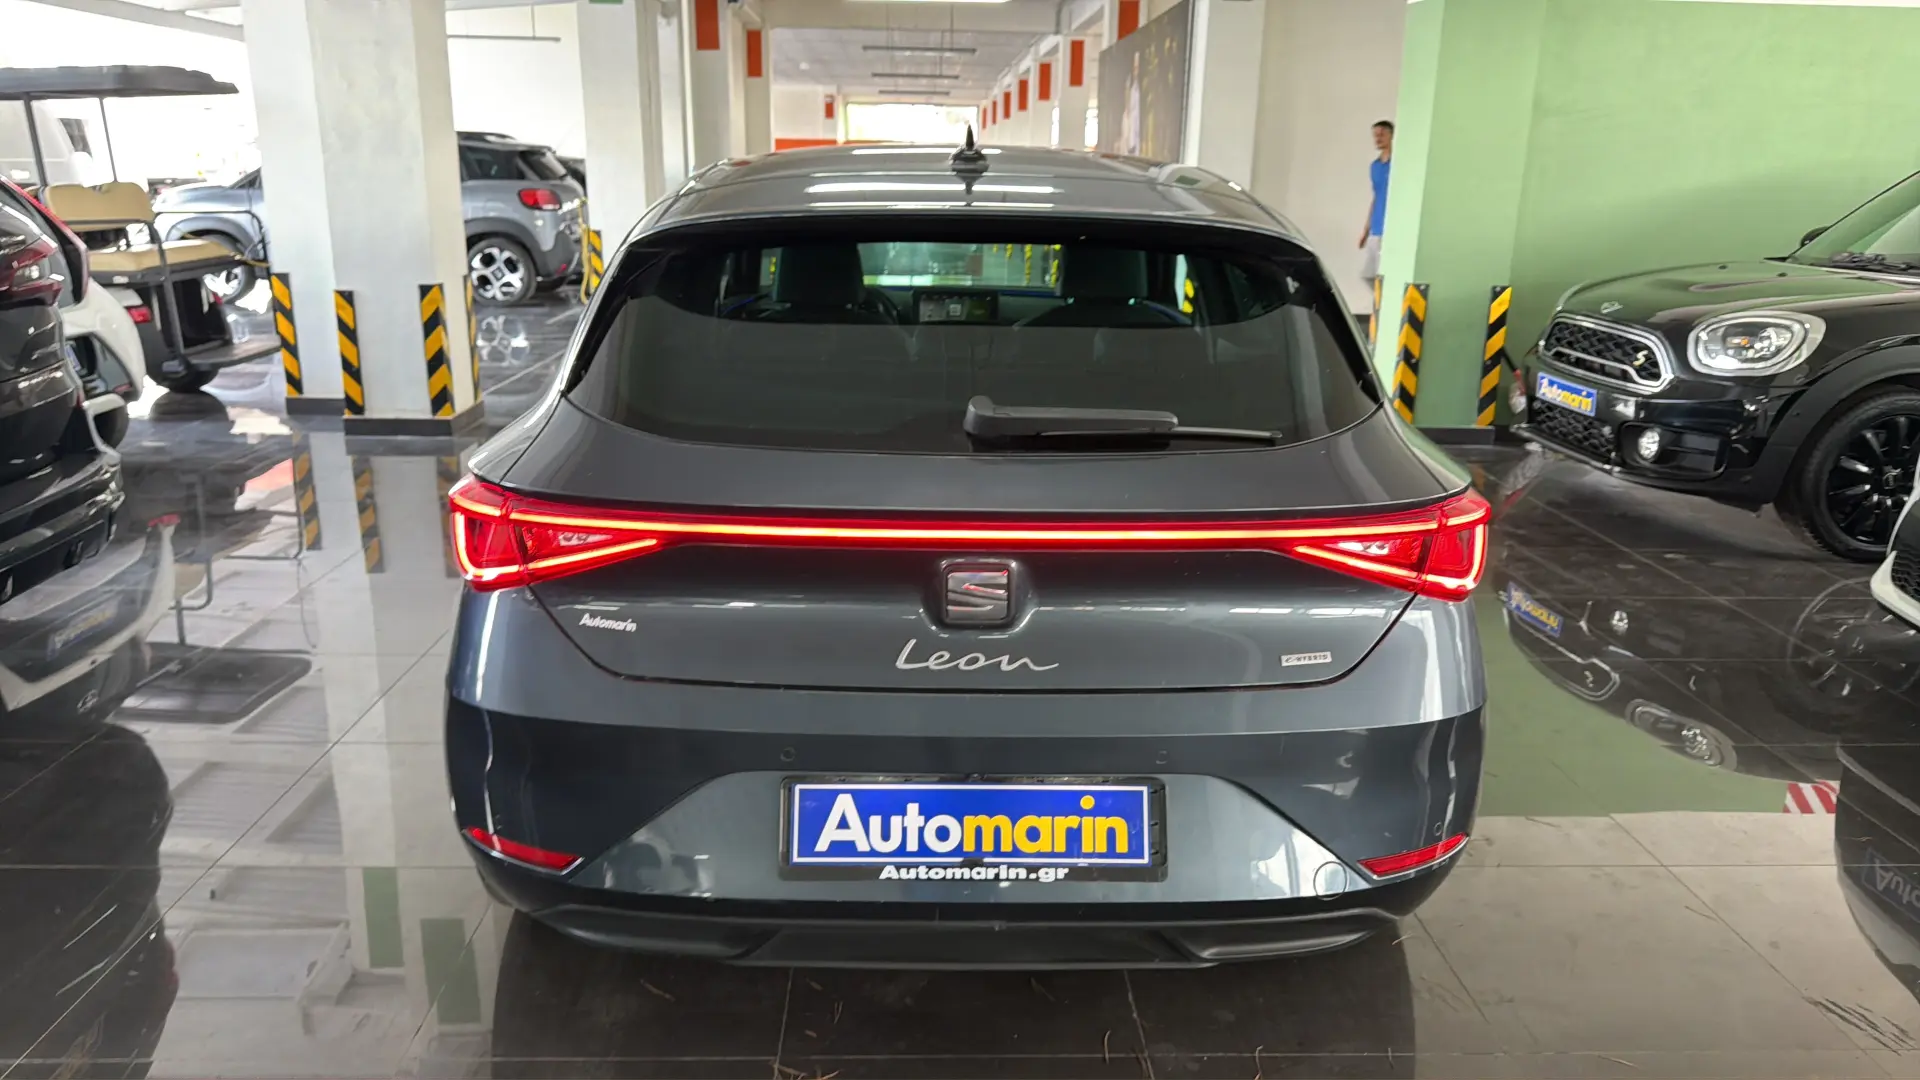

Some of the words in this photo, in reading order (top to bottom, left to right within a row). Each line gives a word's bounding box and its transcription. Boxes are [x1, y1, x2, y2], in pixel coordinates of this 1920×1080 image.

[579, 613, 637, 632] Automarin
[896, 639, 1059, 671] Leon
[813, 793, 1129, 854] Automarin
[879, 864, 1069, 882] Automarin.gr
